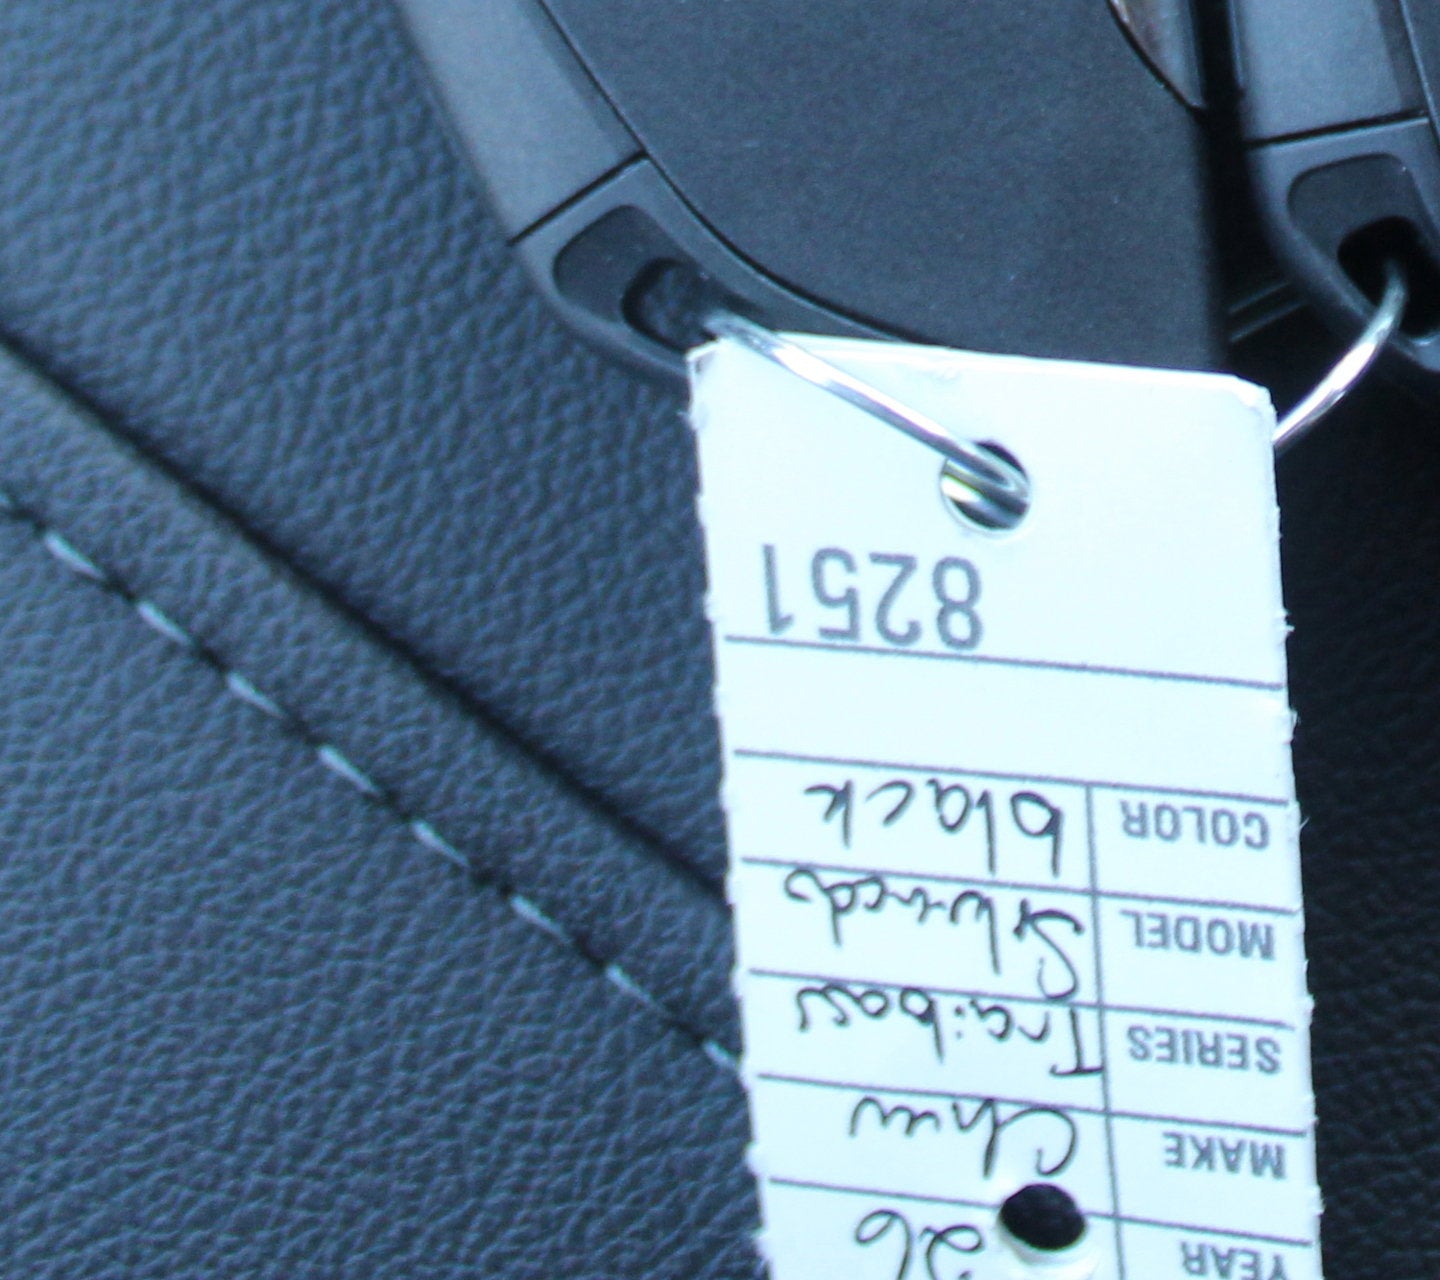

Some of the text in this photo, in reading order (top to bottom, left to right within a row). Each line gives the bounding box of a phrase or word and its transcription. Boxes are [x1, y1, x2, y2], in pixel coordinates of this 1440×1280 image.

[761, 544, 983, 650] 8251
[805, 779, 1063, 876] black
[1120, 801, 1269, 849] COLOR
[1122, 910, 1275, 960] MODEL
[1128, 1026, 1281, 1074] SERIES
[1164, 1132, 1285, 1178] MAKE
[1181, 1240, 1285, 1280] YEAR
